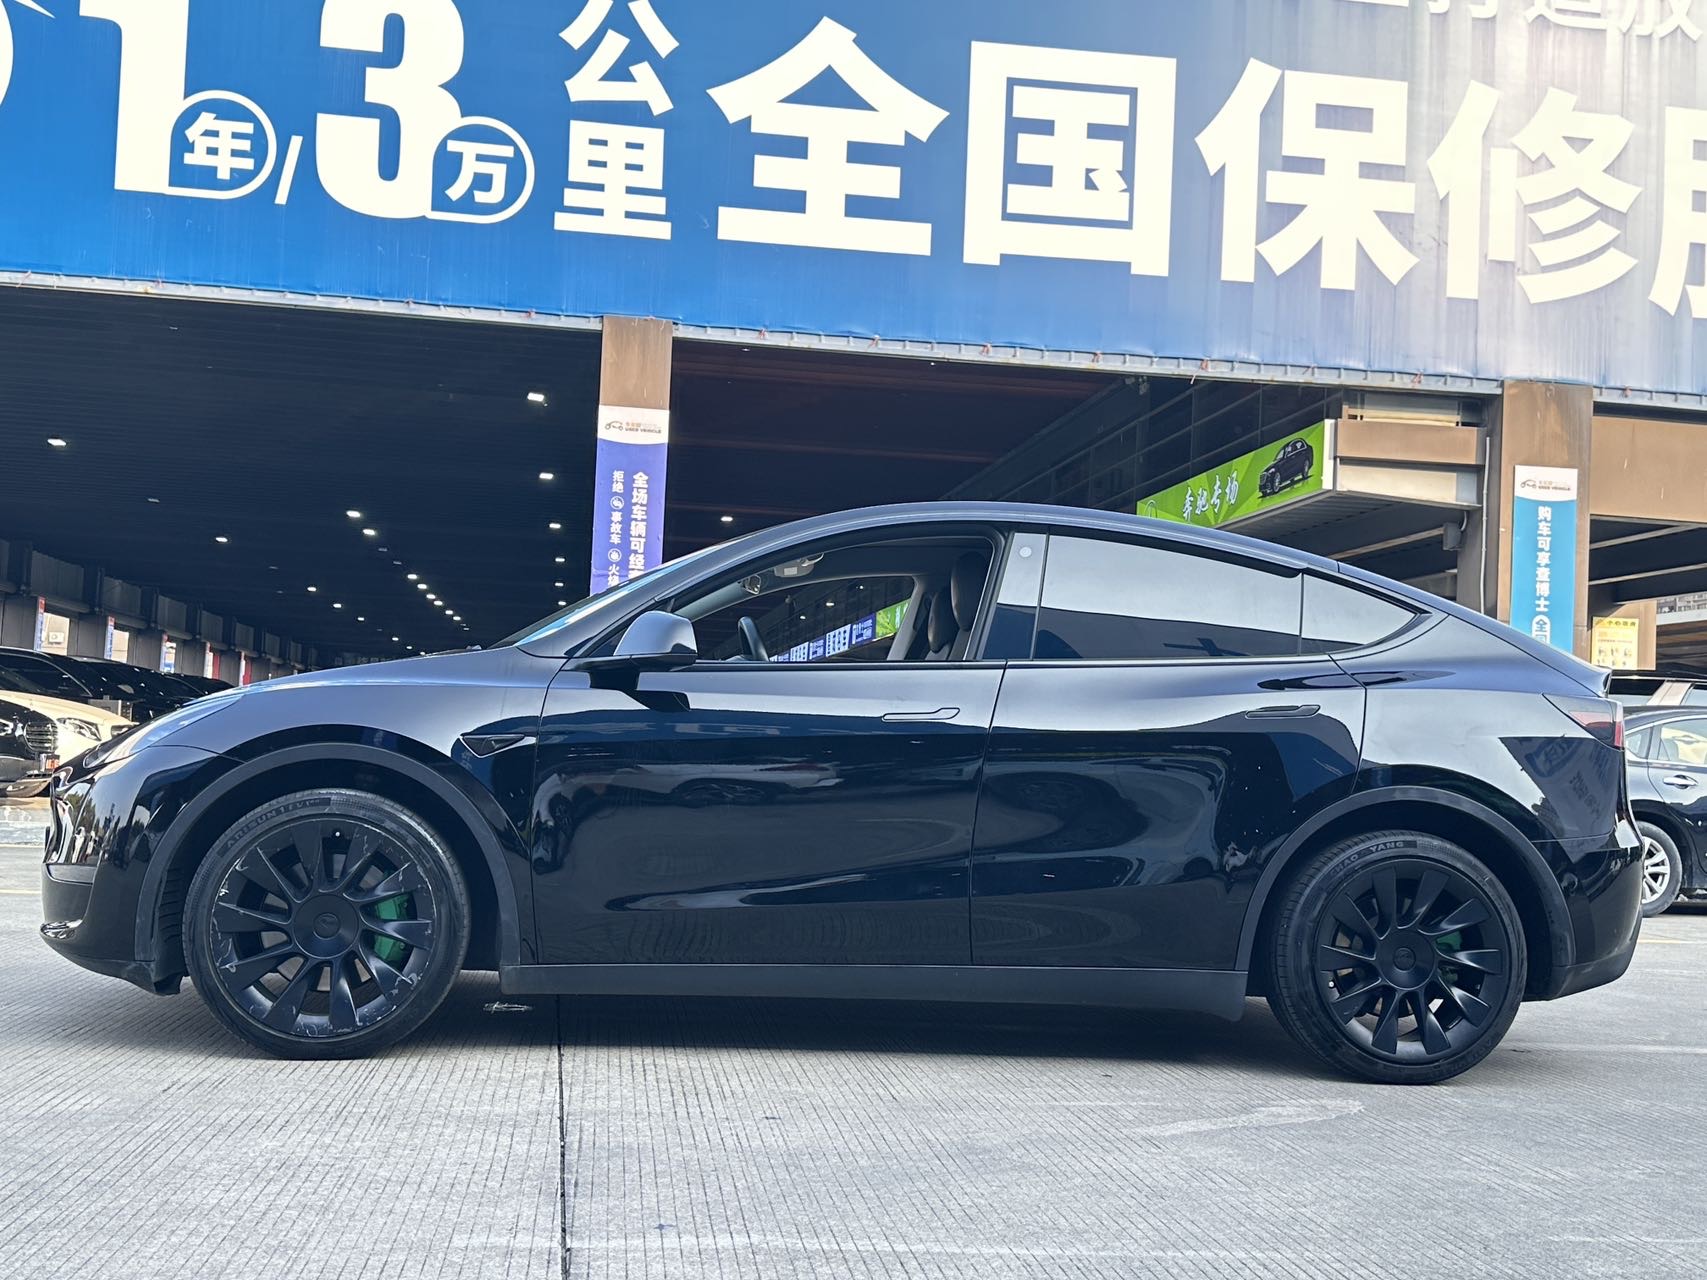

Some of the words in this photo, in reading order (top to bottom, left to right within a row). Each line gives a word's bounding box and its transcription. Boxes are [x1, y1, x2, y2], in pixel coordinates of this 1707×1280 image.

[706, 16, 1707, 319] 全国保修
[1369, 841, 1404, 853] YANG
